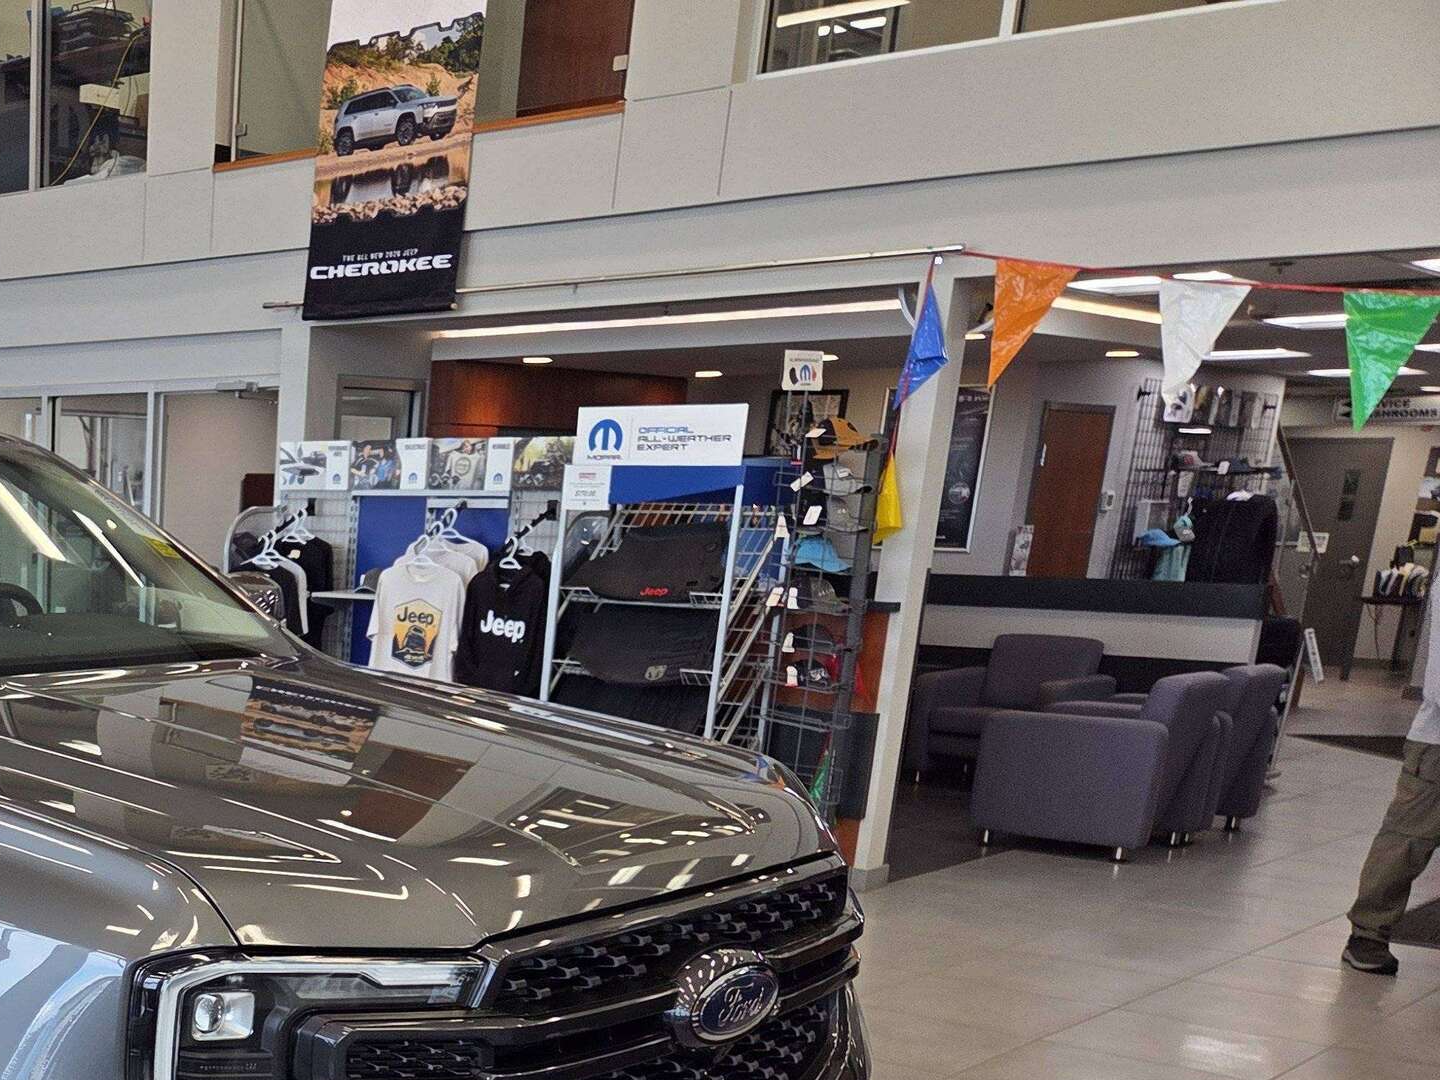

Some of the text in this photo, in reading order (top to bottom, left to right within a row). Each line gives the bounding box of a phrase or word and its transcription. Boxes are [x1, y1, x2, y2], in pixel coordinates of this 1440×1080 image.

[342, 254, 355, 262] THE
[356, 253, 369, 261] ALL
[370, 251, 384, 260] NEW
[402, 248, 419, 257] JEEP
[310, 254, 453, 280] CHEROKEE
[639, 426, 694, 434] OFFICIAL
[637, 443, 689, 451] EXPERT
[640, 586, 669, 596] Jeep
[397, 606, 434, 627] Jeep
[480, 610, 526, 643] Jeep
[718, 981, 766, 1026] Ford
